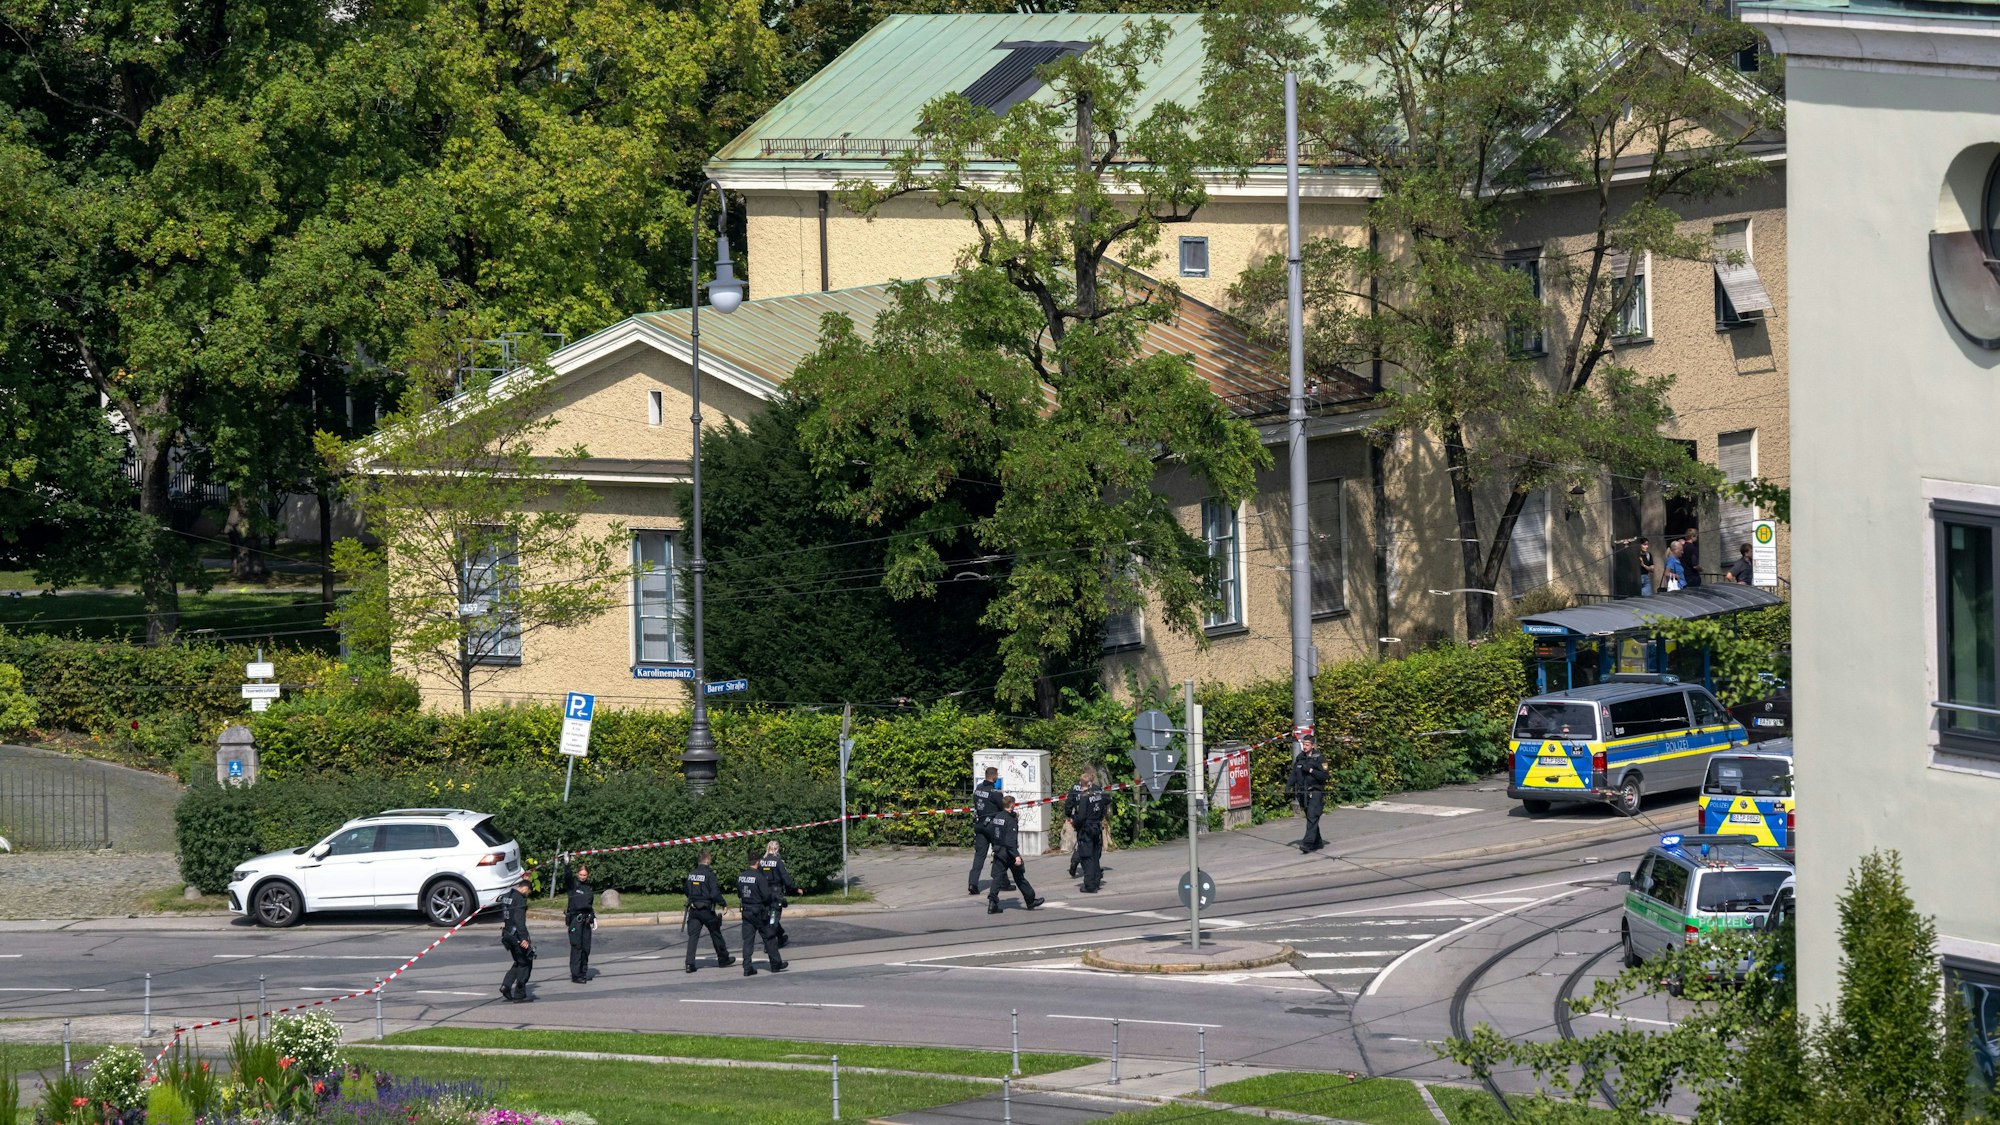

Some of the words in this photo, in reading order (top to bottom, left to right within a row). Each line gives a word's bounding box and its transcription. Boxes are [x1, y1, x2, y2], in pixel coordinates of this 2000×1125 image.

[463, 604, 478, 612] 459
[1528, 626, 1562, 634] Karolinenplatz
[637, 668, 691, 679] Karolinenplatz
[707, 684, 724, 693] Barer
[726, 680, 746, 691] Straße
[569, 695, 586, 716] P
[1520, 745, 1538, 753] POLIZEI
[1665, 740, 1689, 753] POLIZEI
[1229, 767, 1249, 779] offen
[1710, 801, 1729, 809] POLIZEI
[688, 874, 706, 882] POLIZEI
[738, 876, 756, 884] POLIZEI
[1699, 917, 1743, 928] POLIZEI
